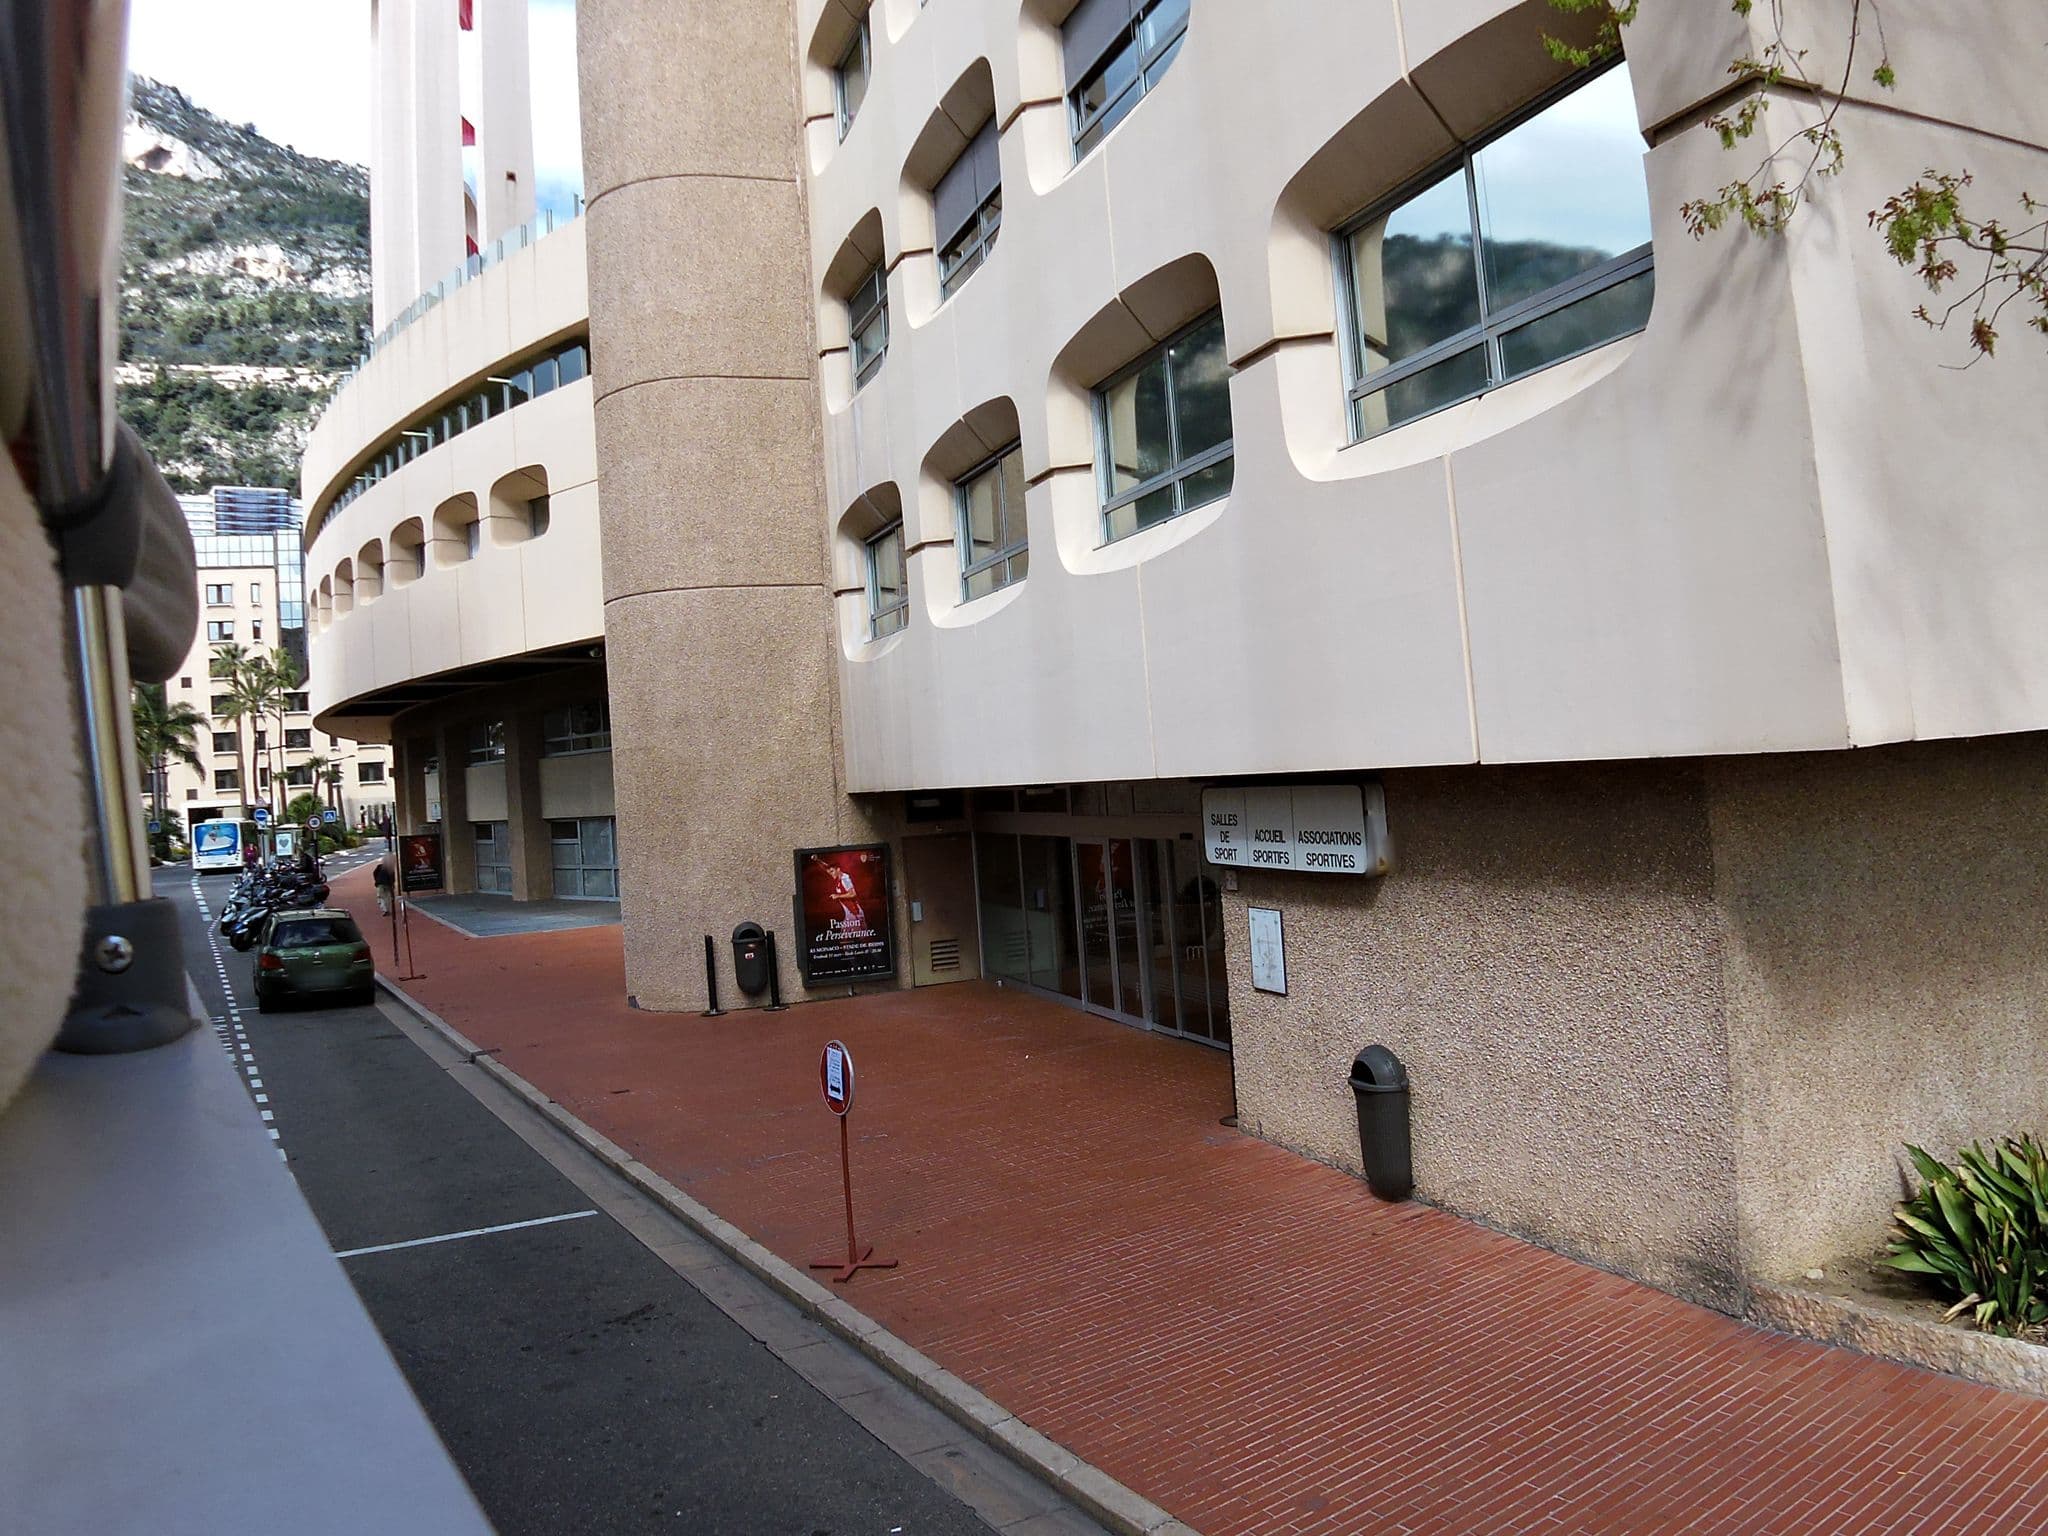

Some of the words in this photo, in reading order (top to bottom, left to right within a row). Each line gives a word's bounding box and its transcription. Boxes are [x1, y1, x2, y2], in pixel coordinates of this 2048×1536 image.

[1211, 813, 1238, 827] SALLES
[1220, 831, 1230, 843] DE
[1255, 829, 1286, 843] ACCUEIL
[1298, 830, 1362, 846] ASSOCIATIONS
[1215, 847, 1238, 861] SPORT
[1253, 850, 1290, 864] SPORTIFS
[1306, 852, 1356, 868] SPORTIVES
[830, 919, 861, 929] Passion
[815, 934, 824, 942] et
